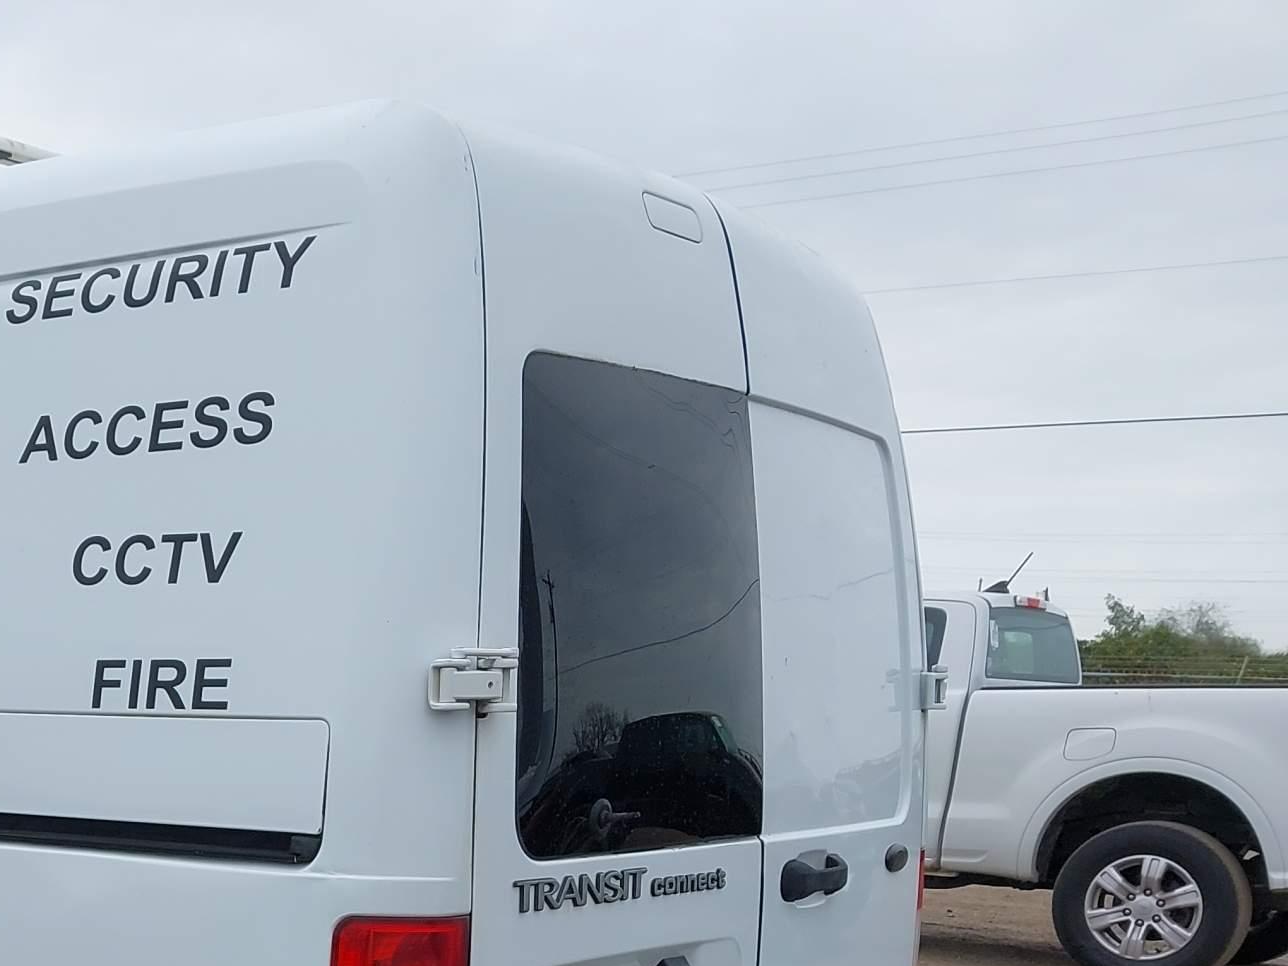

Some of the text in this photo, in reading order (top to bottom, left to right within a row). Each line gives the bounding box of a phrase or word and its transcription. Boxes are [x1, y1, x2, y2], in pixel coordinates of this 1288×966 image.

[5, 235, 317, 324] SECURITY
[19, 391, 276, 463] ACCESS
[72, 531, 243, 585] CCTV
[91, 658, 233, 710] FIRE
[512, 867, 727, 914] TRANSIT connect
